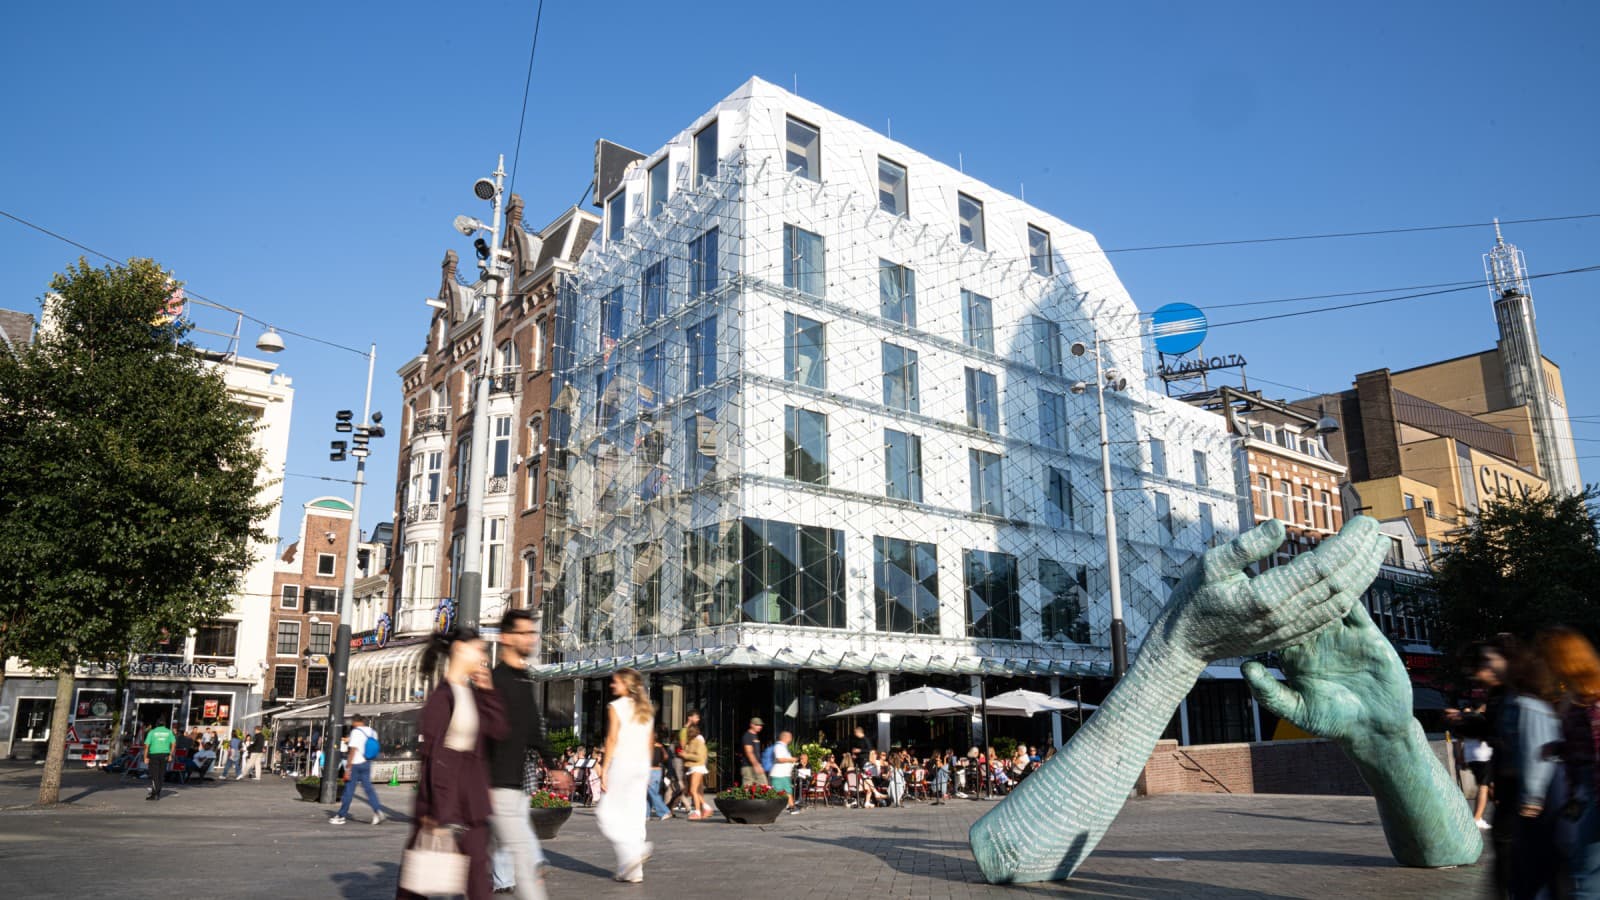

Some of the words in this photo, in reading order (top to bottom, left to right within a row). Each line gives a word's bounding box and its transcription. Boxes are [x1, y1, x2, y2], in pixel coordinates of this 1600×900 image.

[1180, 353, 1247, 373] MINOLTA
[104, 661, 172, 675] BRGER
[176, 663, 217, 678] KING
